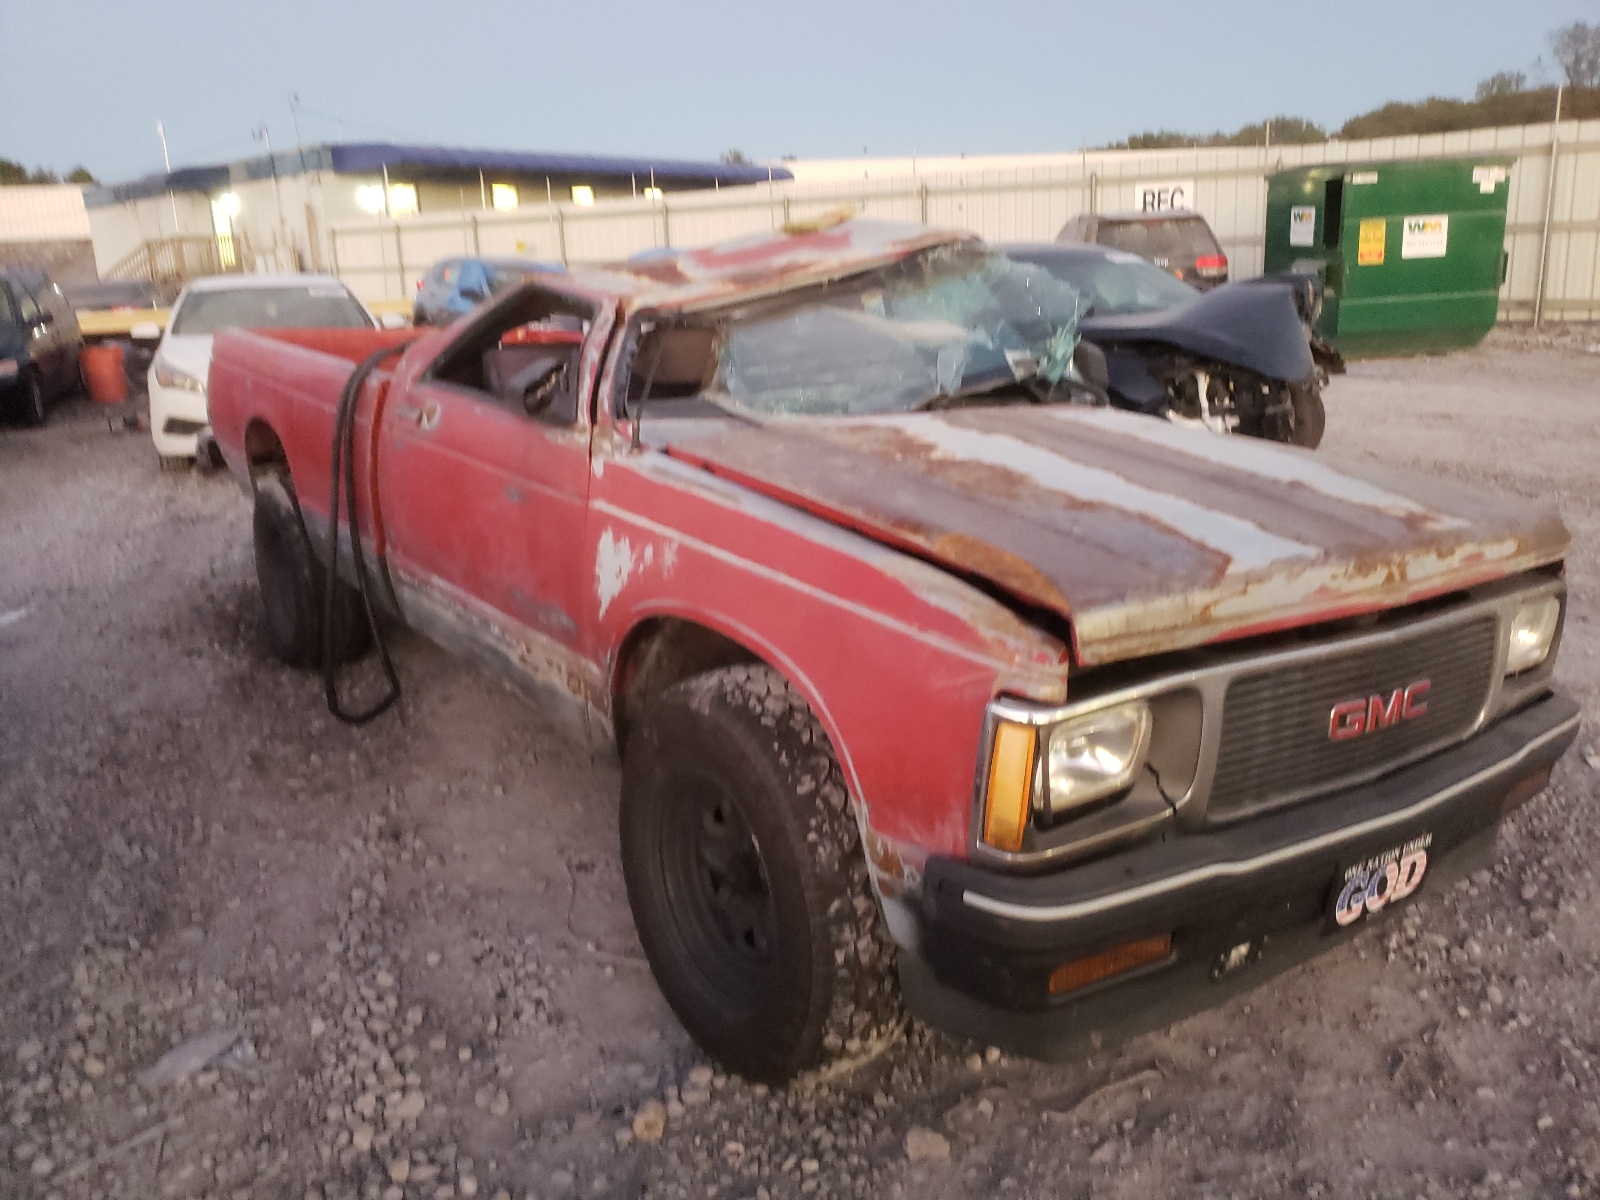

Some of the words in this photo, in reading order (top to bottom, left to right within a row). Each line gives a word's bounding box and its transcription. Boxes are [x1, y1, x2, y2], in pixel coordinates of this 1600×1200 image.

[1407, 220, 1442, 235] WM
[1328, 679, 1432, 741] GMC
[1335, 849, 1427, 927] GOD
